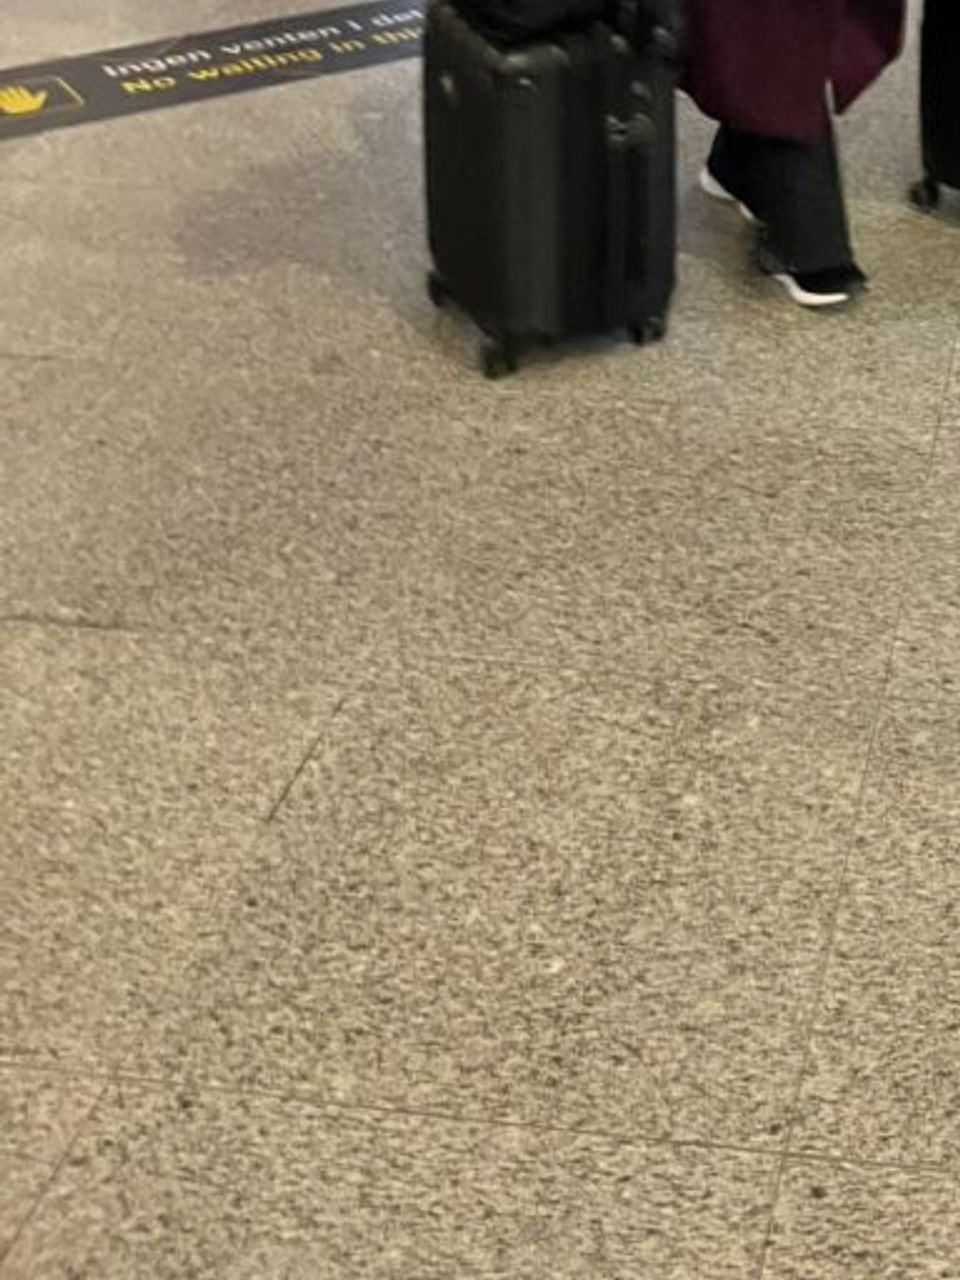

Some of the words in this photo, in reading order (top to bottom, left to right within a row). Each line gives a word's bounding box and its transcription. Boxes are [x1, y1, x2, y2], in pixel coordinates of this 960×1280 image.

[102, 49, 212, 78] Ingen
[219, 26, 342, 55] venten
[120, 76, 177, 94] No
[186, 48, 324, 81] waiting
[328, 39, 366, 55] in
[370, 26, 426, 45] thi
